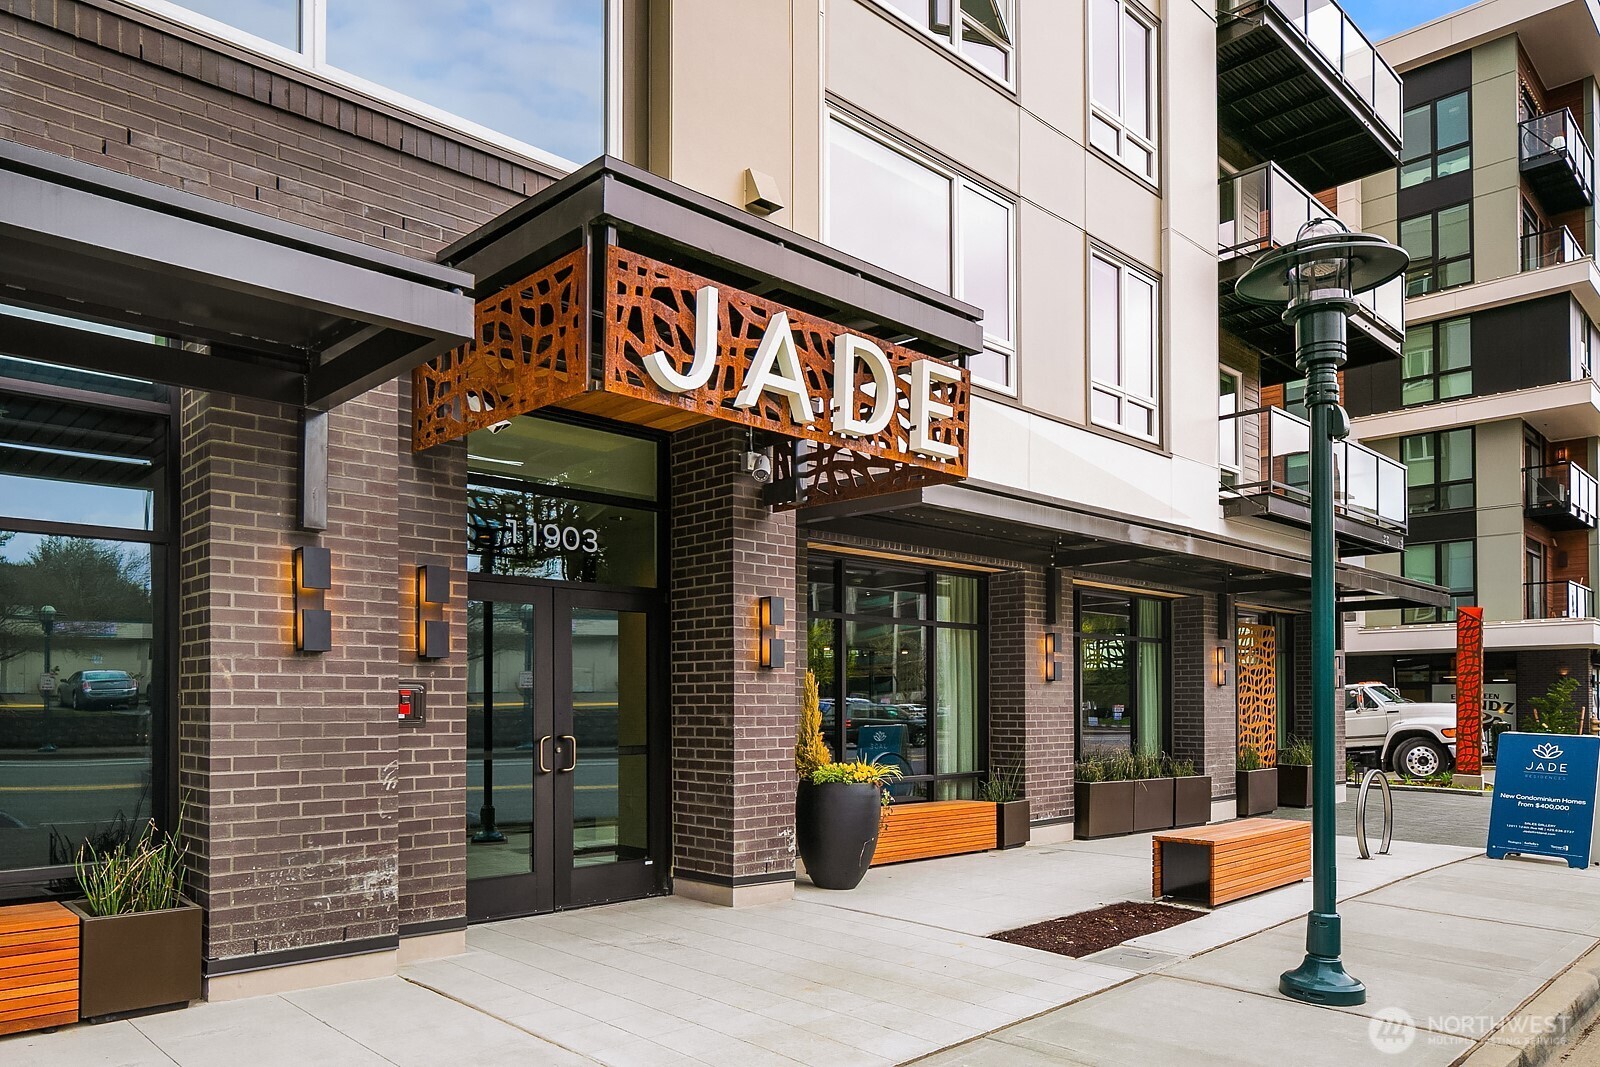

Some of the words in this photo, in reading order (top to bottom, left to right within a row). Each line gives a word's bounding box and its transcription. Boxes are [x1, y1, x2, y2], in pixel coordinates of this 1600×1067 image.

[642, 285, 963, 459] JADE
[506, 519, 598, 553] 11903
[1525, 761, 1568, 773] JADE
[1516, 794, 1561, 802] Condominium
[1535, 803, 1569, 811] $400,000
